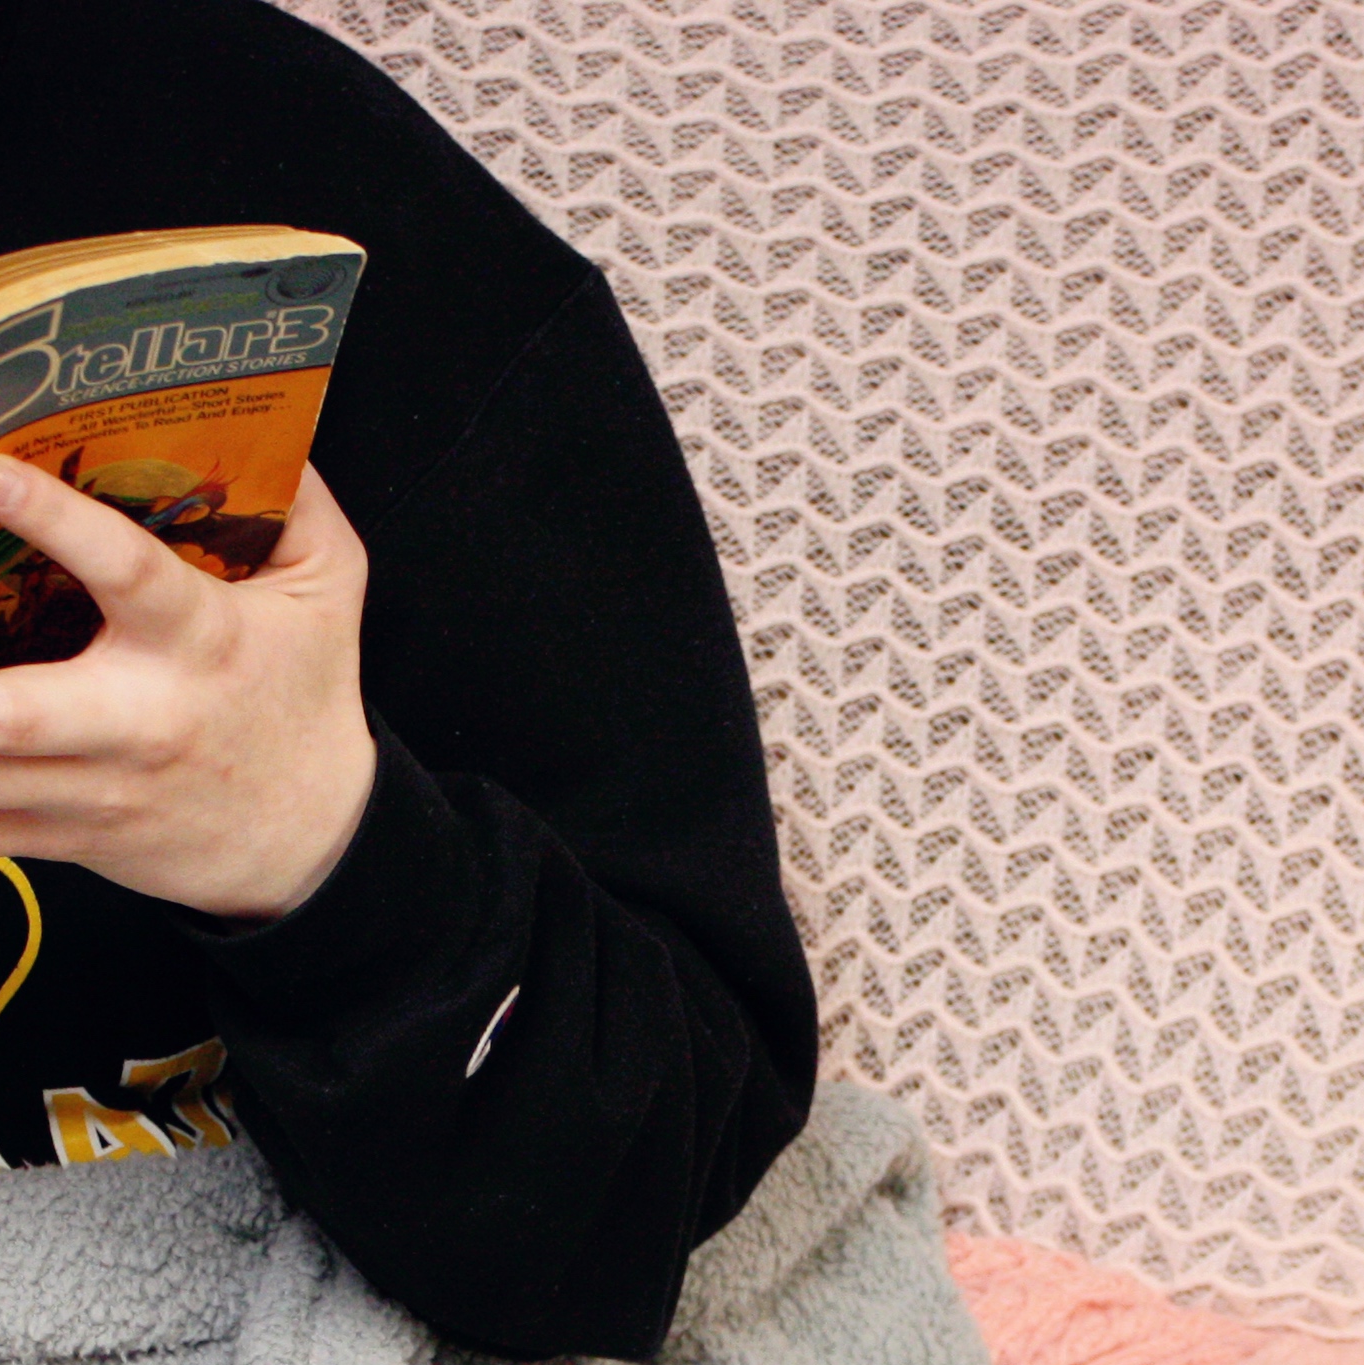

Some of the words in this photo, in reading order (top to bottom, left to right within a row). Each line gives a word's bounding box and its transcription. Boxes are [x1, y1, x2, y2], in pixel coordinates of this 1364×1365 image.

[225, 351, 307, 373] STORIES
[69, 404, 114, 425] FIRST
[118, 386, 230, 413] PUBLICATION
[236, 390, 286, 403] Stories
[134, 419, 150, 431] To
[153, 413, 193, 427] Read
[196, 408, 227, 421] And
